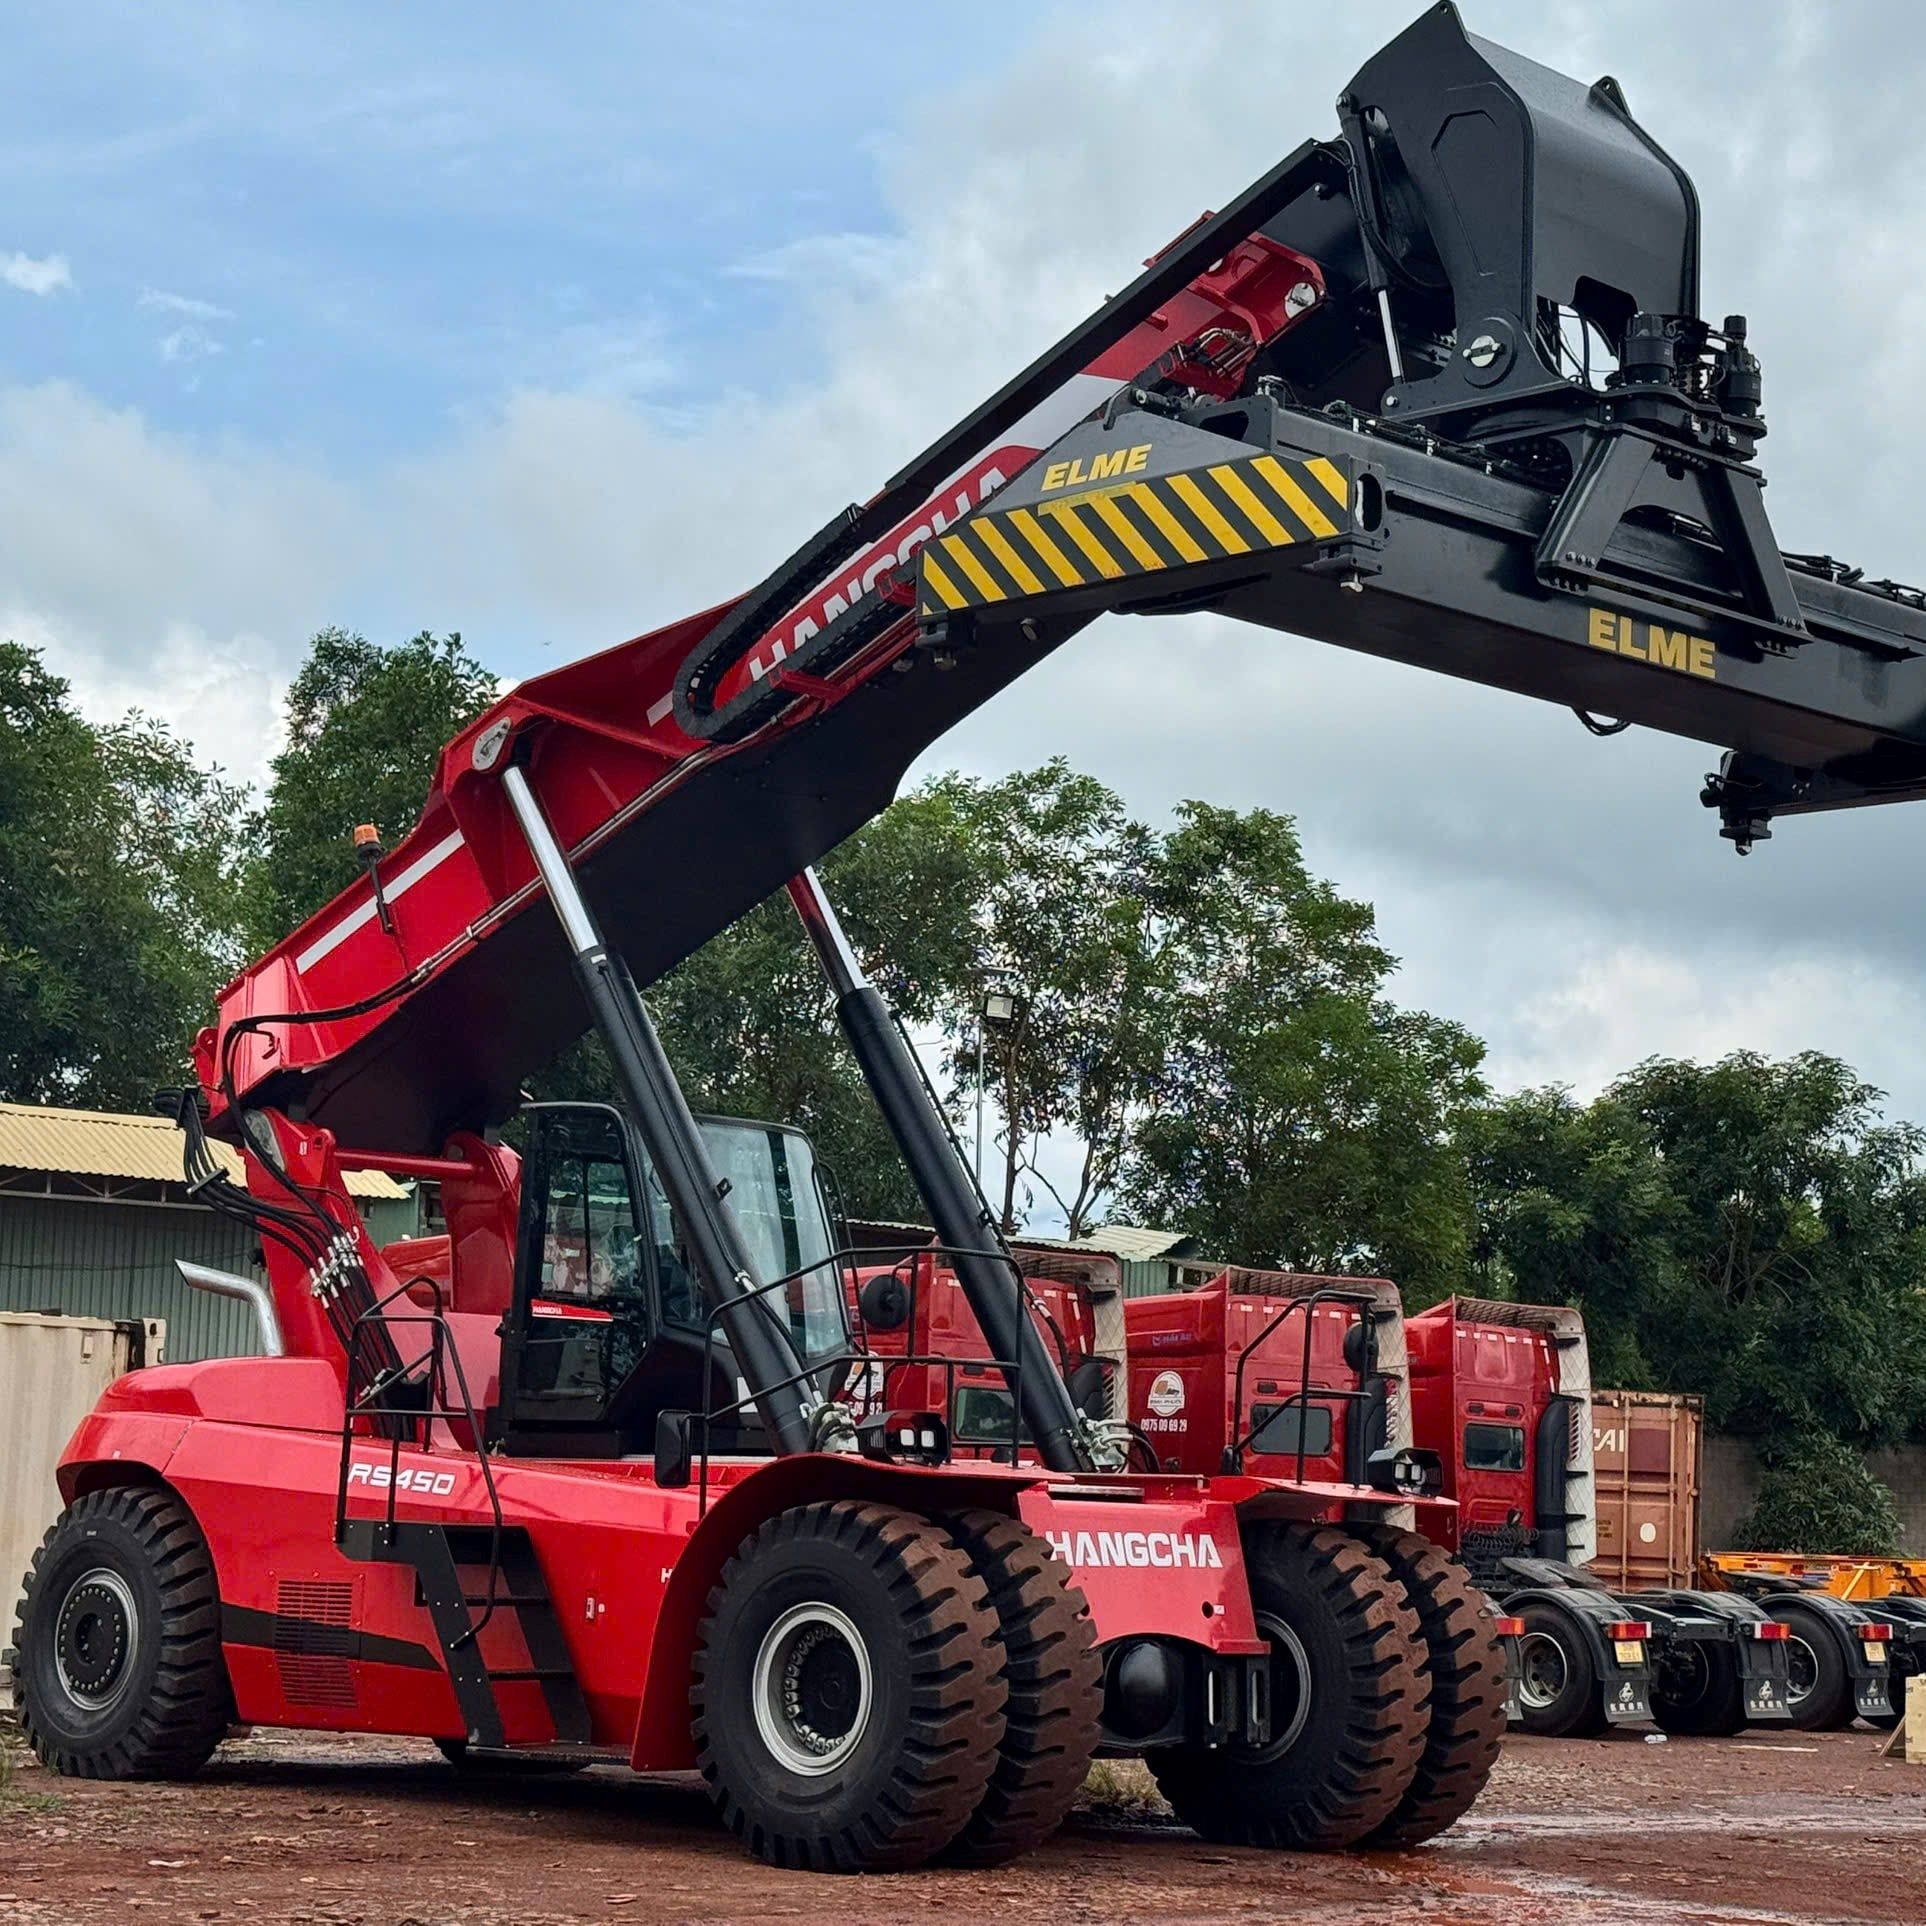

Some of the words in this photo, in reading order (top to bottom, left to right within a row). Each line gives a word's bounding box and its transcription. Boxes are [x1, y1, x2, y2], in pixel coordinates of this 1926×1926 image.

[1040, 443, 1153, 492] ELME
[1588, 607, 1716, 680] ELME
[1158, 1418, 1168, 1432] 09
[347, 1462, 456, 1496] RS450
[1045, 1530, 1223, 1568] HANGCHA
